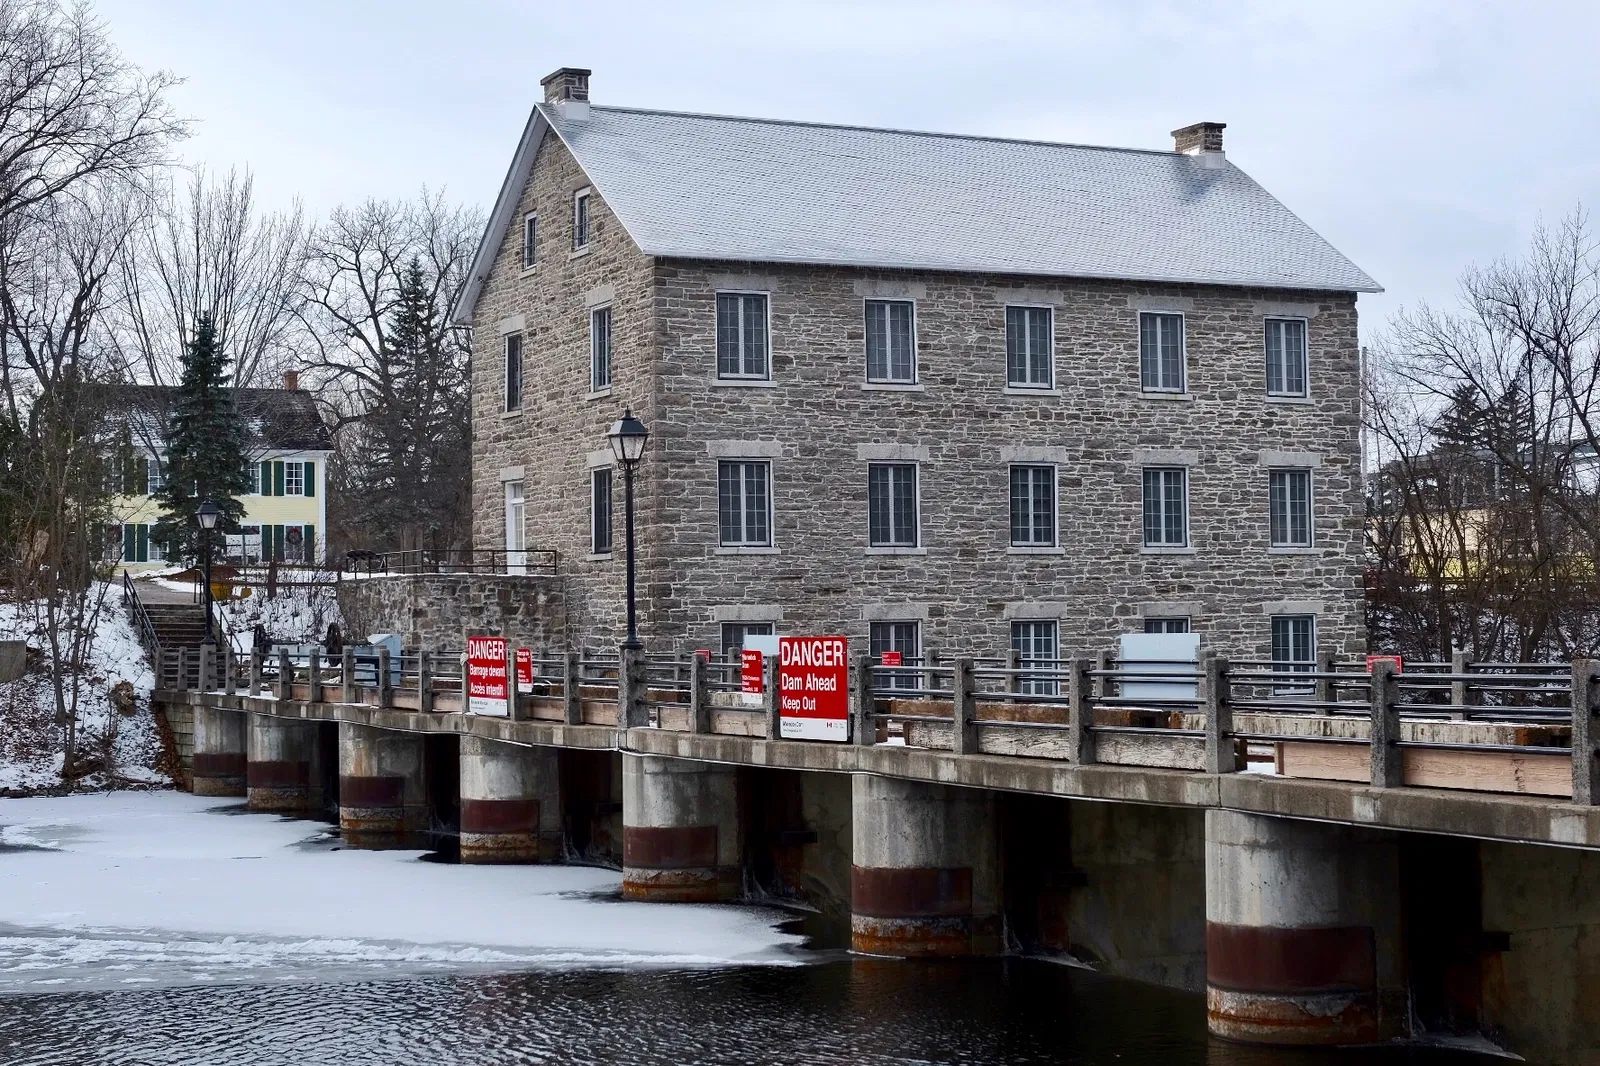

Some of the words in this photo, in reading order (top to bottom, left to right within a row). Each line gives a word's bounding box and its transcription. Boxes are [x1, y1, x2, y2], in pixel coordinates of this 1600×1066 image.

[469, 640, 505, 660] DANGER
[781, 641, 844, 667] DANGER
[469, 664, 488, 679] Barrage
[489, 665, 505, 677] devant
[486, 682, 504, 696] interdit
[781, 673, 803, 690] Dam
[805, 673, 837, 691] Ahead
[782, 696, 801, 713] Keep
[802, 696, 816, 710] Out
